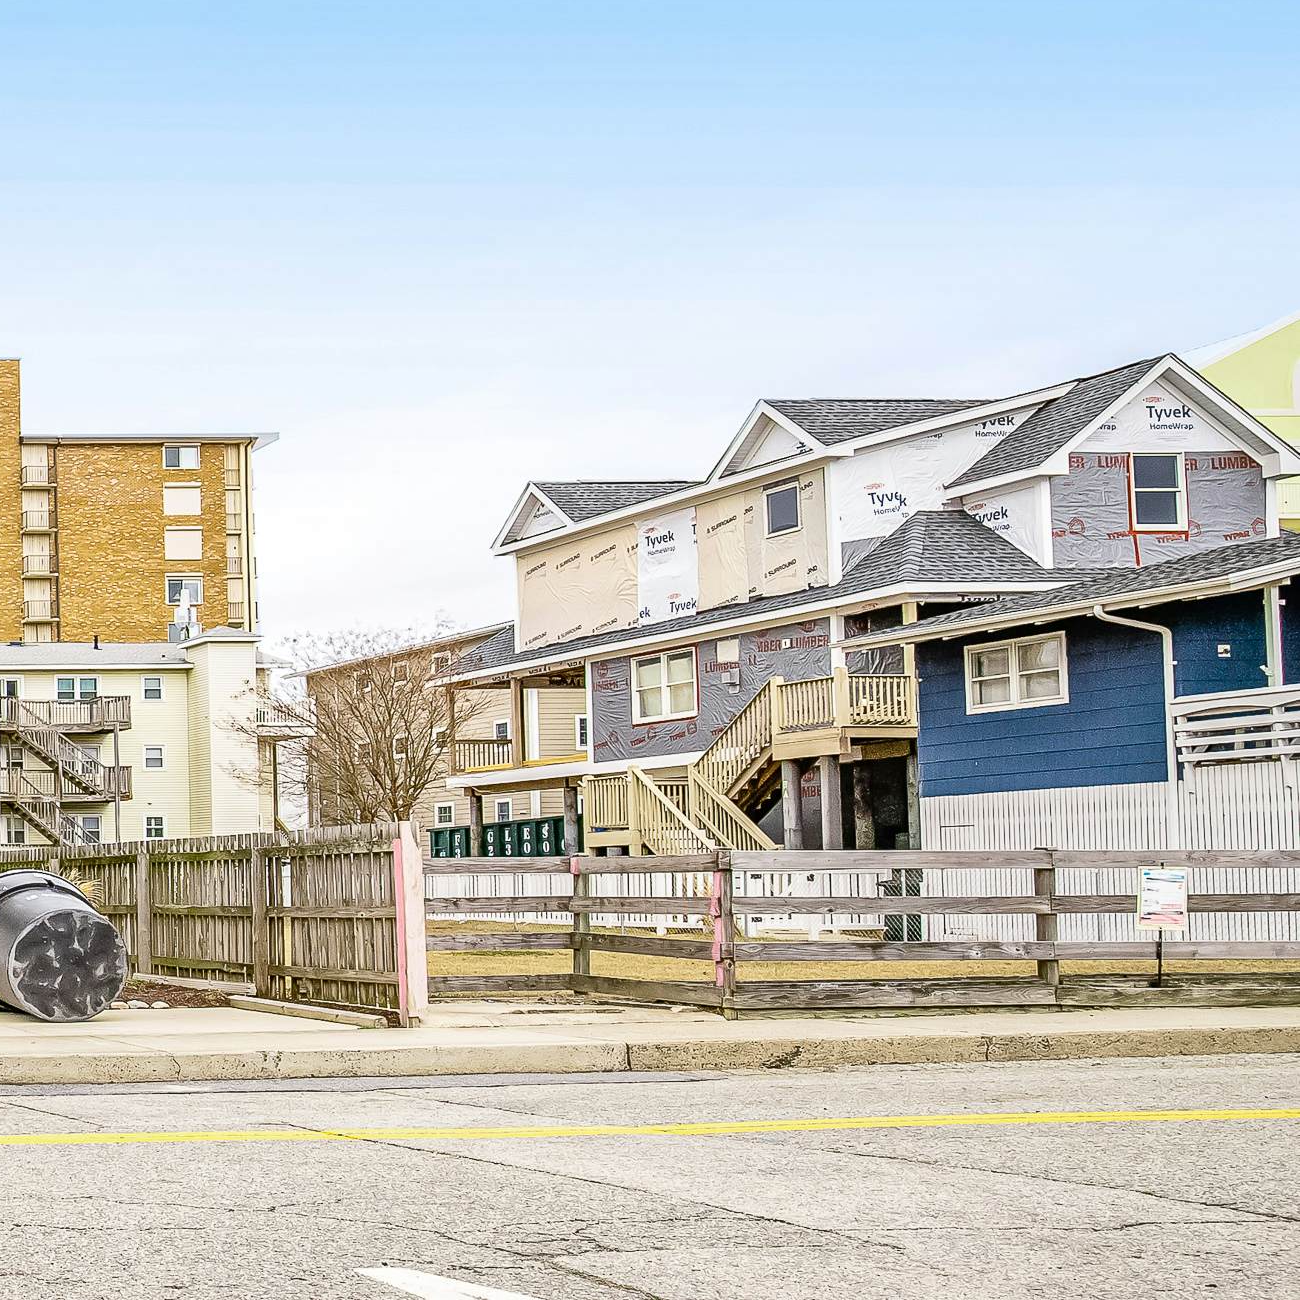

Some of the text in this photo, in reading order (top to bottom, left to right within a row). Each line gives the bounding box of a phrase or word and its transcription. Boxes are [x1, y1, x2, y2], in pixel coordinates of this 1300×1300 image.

[1145, 405, 1191, 422] Tyvek
[974, 416, 1015, 429] yvek
[1149, 423, 1194, 431] HomeWrap
[867, 491, 907, 507] Tyvek
[645, 530, 675, 549] Tyvek
[669, 598, 697, 615] Tyvek
[791, 635, 829, 648] LUMBER
